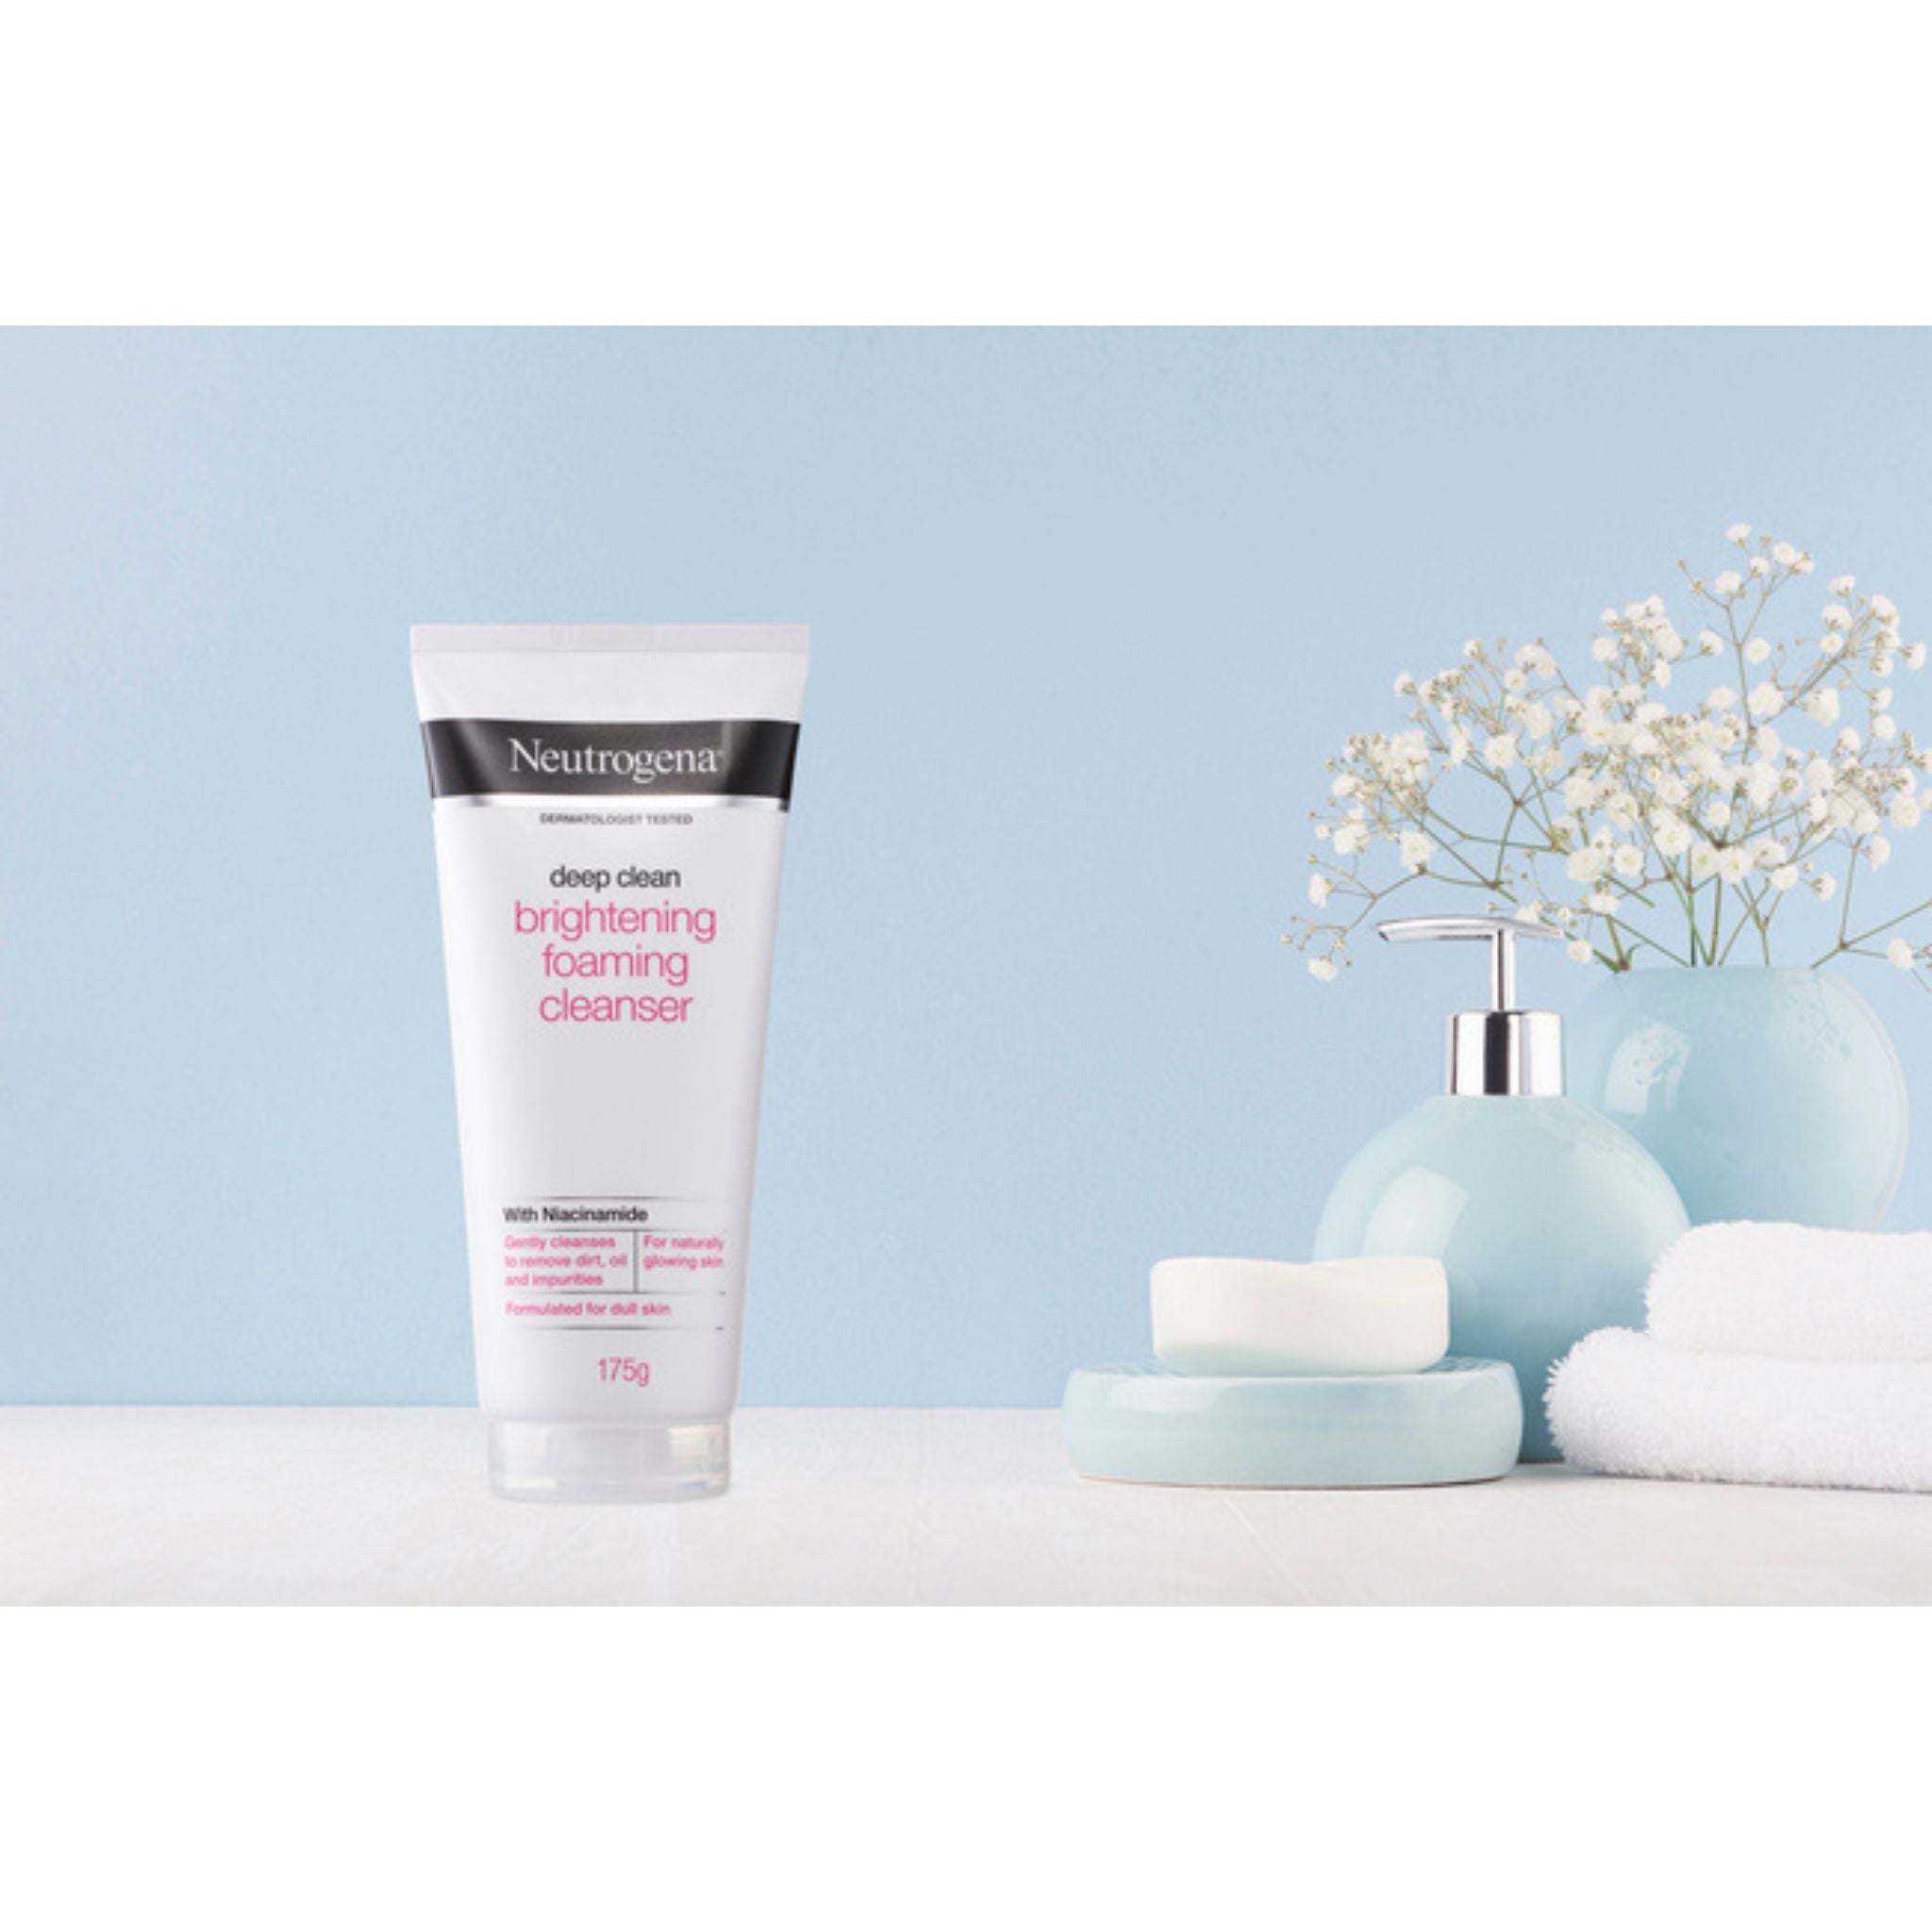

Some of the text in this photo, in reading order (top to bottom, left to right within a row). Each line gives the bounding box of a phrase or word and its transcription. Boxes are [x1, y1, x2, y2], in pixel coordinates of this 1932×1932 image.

[508, 738, 718, 784] Neutrogena
[540, 812, 693, 825] DERMATOLOGIST TESTED
[549, 864, 681, 892] deep clean
[514, 899, 717, 943] brightening
[541, 944, 690, 986] foaming
[539, 988, 694, 1023] cleanser
[503, 1206, 649, 1223] With Niacinamide
[504, 1235, 616, 1251] Gently cleanses
[643, 1235, 667, 1249] For
[505, 1254, 628, 1269] to remove dirt, oil
[642, 1255, 724, 1271] glowing skin
[505, 1274, 605, 1289] and impurities
[505, 1302, 672, 1316] Formulated for dull skin
[597, 1357, 650, 1388] 175g
